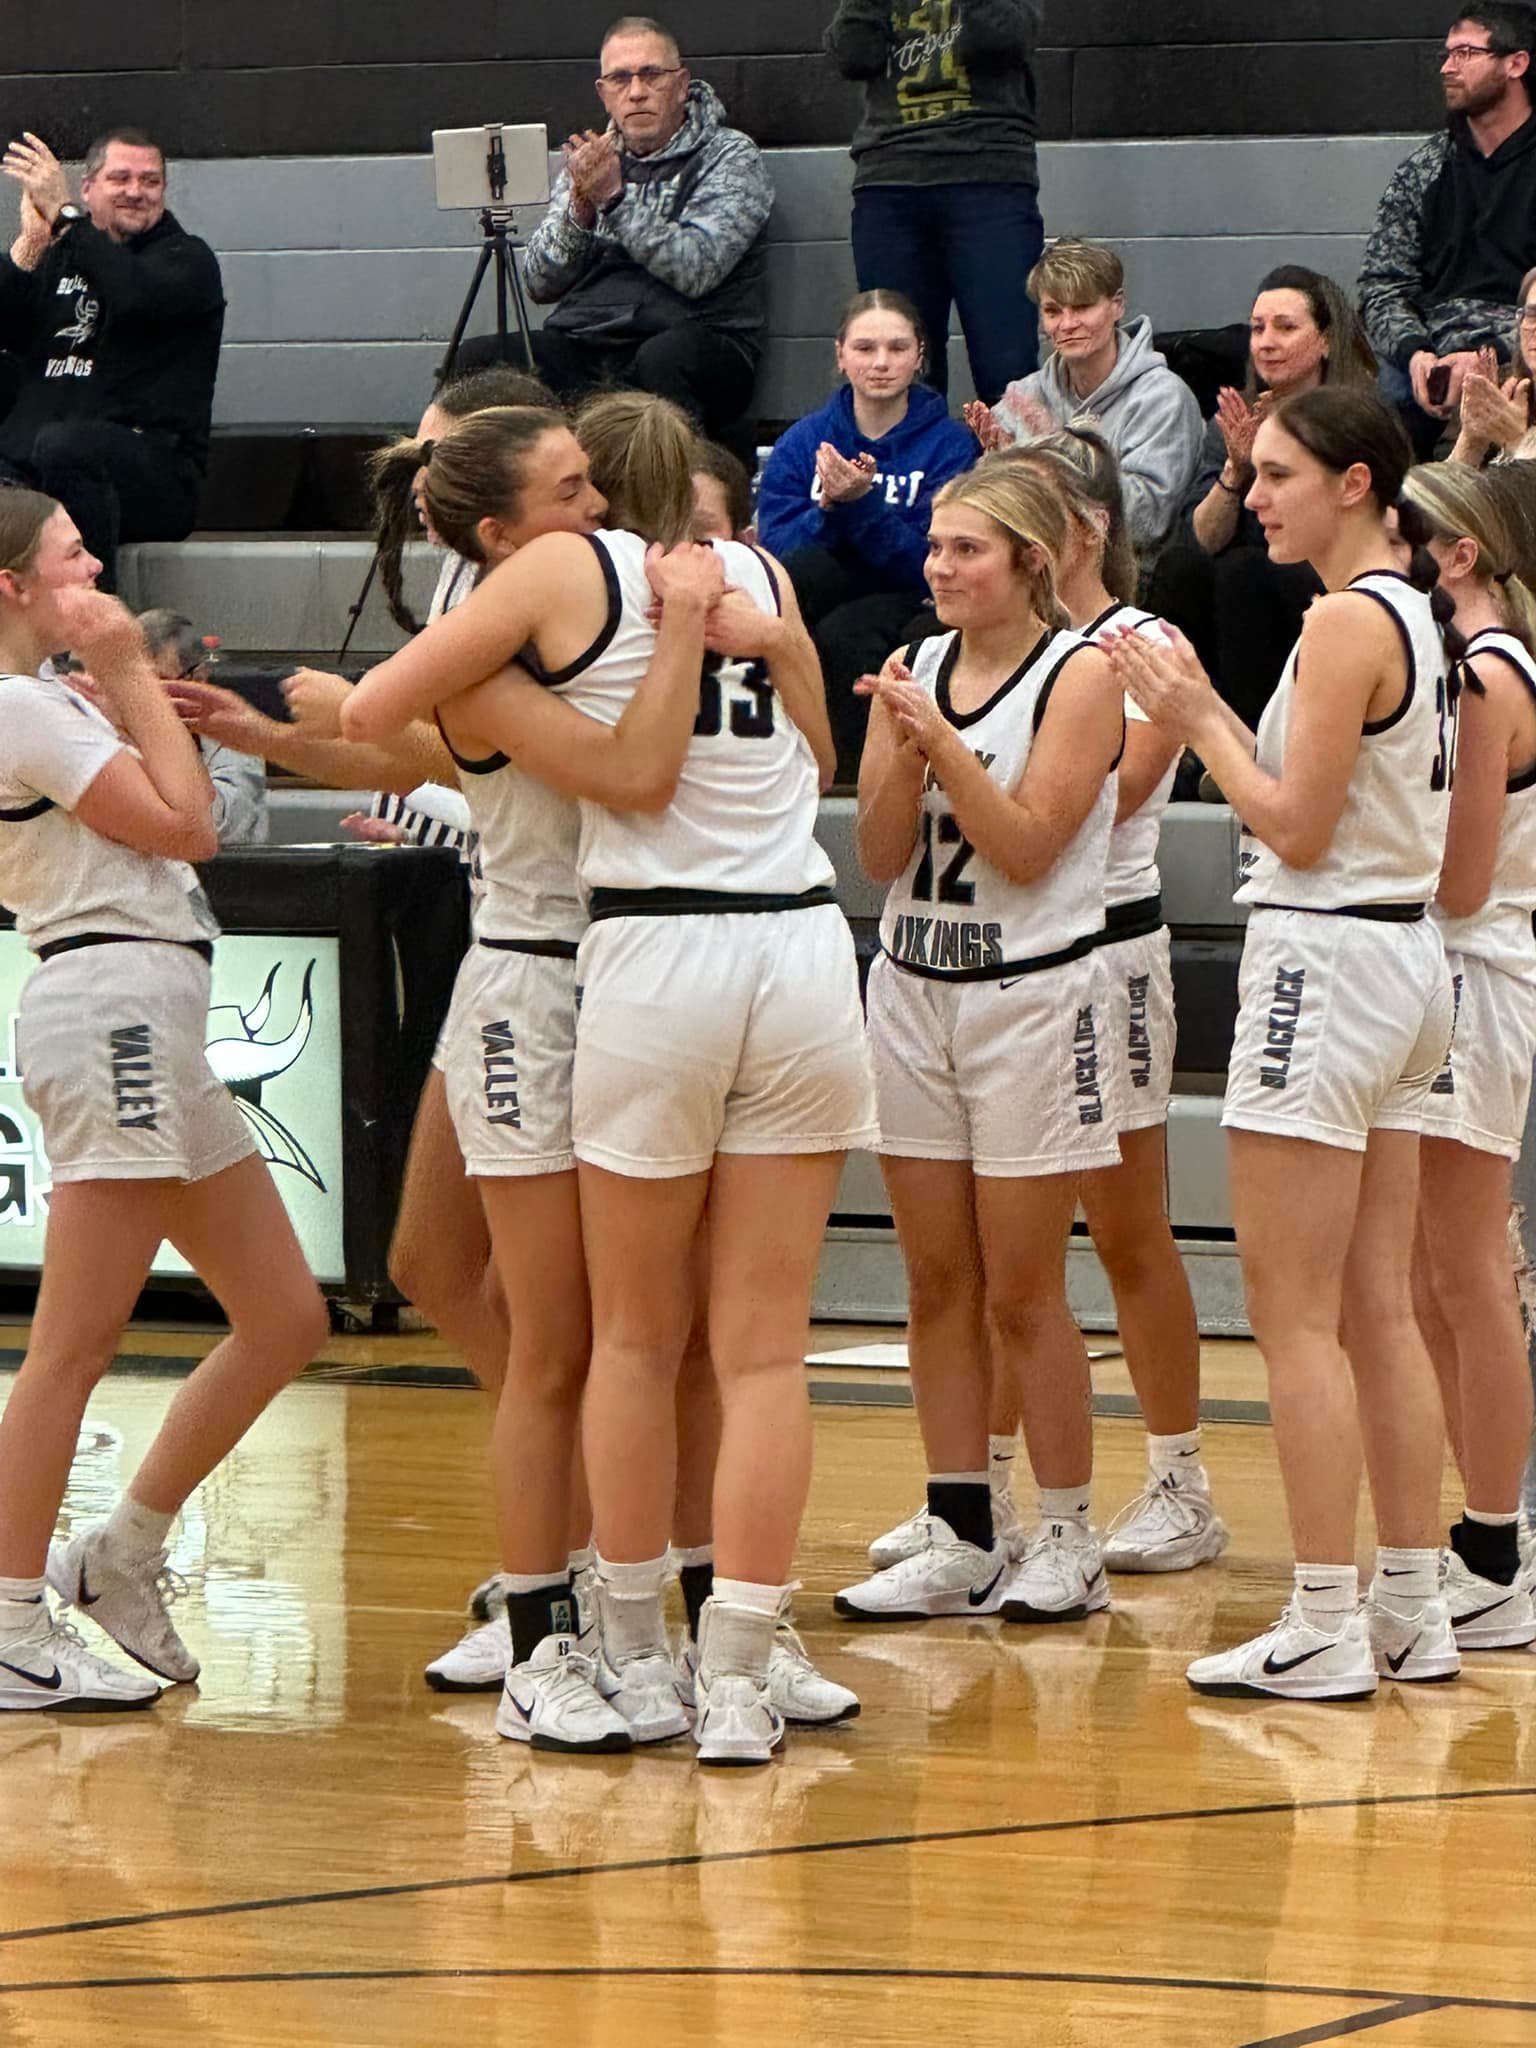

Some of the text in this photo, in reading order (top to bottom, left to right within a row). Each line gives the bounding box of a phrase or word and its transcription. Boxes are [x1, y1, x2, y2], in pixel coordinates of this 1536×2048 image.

[911, 811, 975, 905] 12
[110, 1024, 158, 1131] VALLEY
[481, 1019, 522, 1130] VALLEY
[1073, 1003, 1103, 1125] BLACKLICK
[1127, 973, 1153, 1089] BLACKLICK
[1259, 966, 1306, 1090] BLACKLICK
